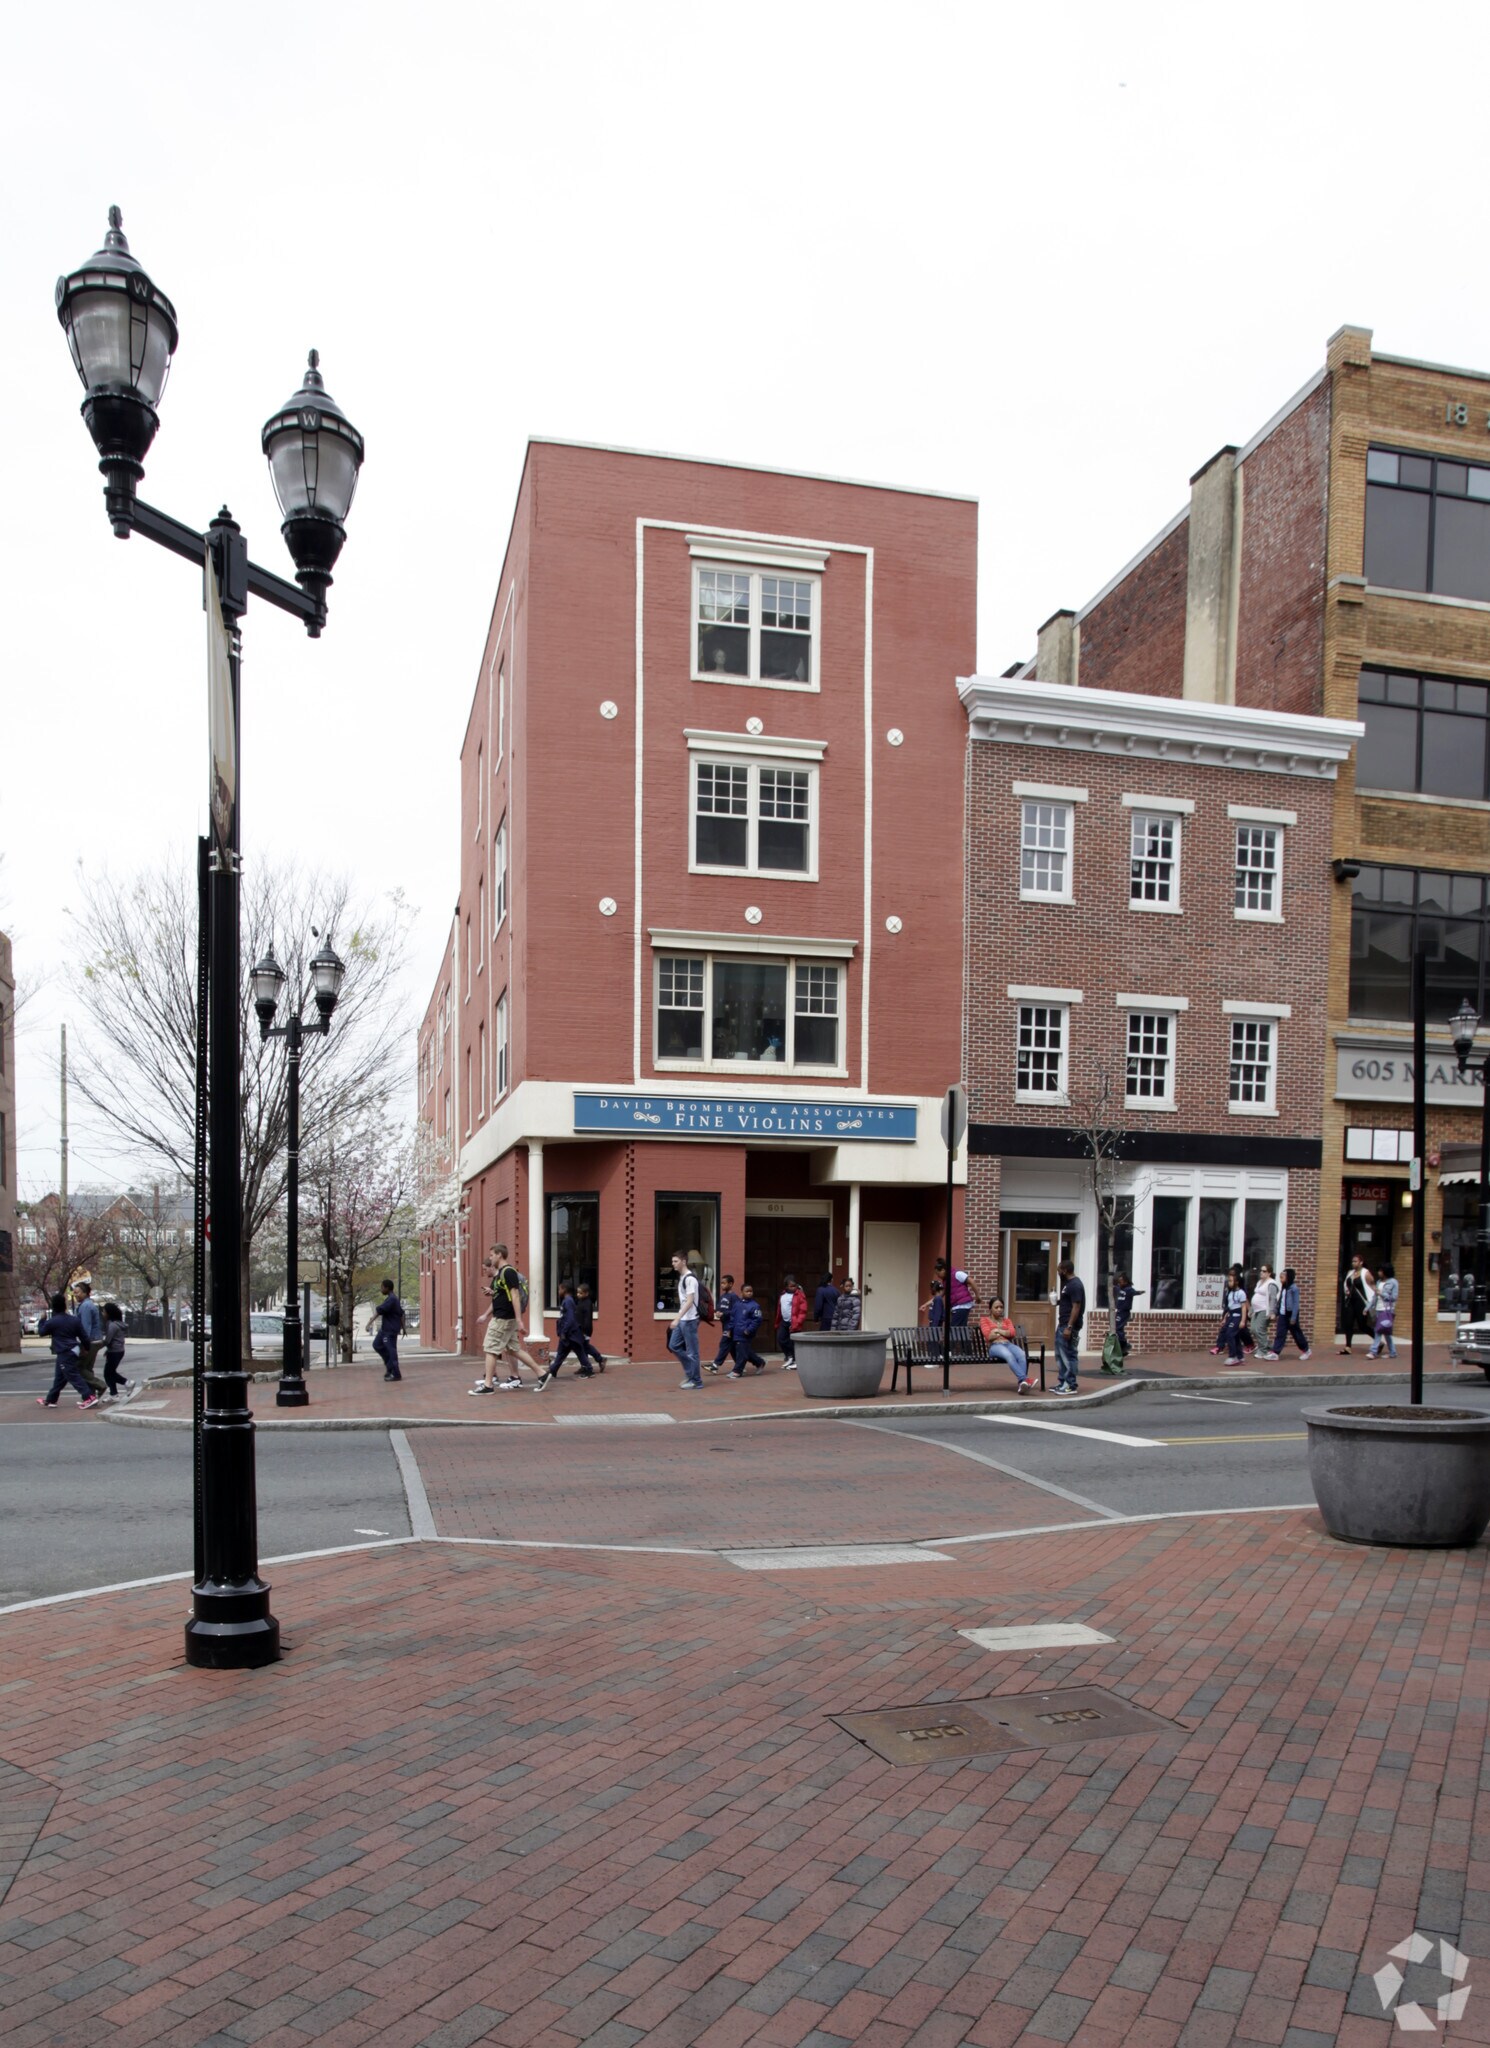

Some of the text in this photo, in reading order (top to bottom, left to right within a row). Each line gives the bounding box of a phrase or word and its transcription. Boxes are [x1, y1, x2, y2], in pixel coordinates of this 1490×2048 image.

[132, 277, 149, 297] W
[302, 412, 317, 427] W
[1445, 401, 1468, 425] 18
[1351, 1059, 1395, 1081] 605
[600, 1099, 895, 1119] DAVID BROMBERG & ASSOCIATES
[674, 1112, 823, 1131] FINE VIOLINS
[1351, 1186, 1387, 1199] SPACE
[767, 1203, 784, 1212] 601
[1208, 1276, 1224, 1284] SALE
[1197, 1290, 1219, 1298] LEASE
